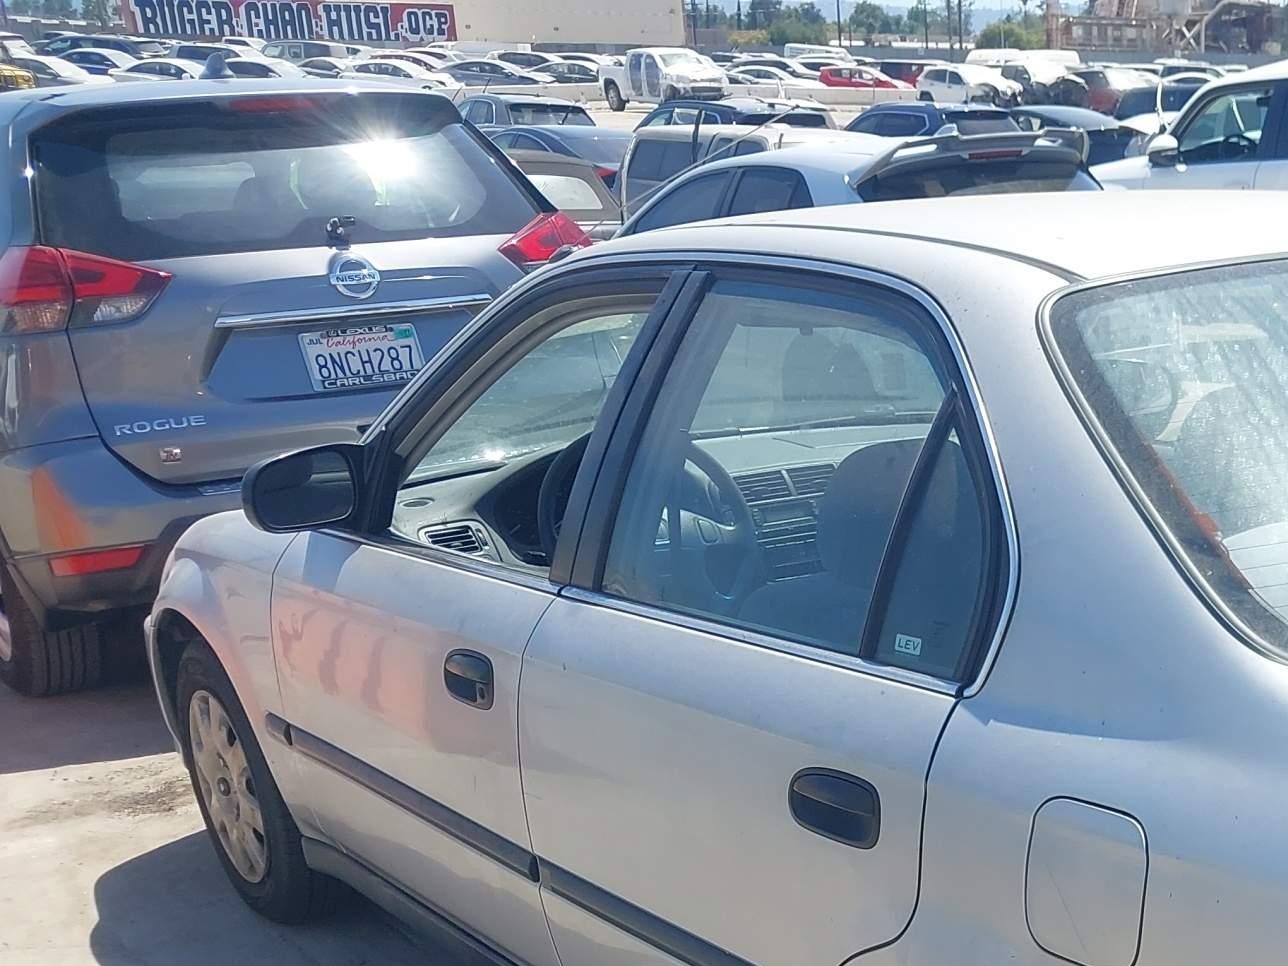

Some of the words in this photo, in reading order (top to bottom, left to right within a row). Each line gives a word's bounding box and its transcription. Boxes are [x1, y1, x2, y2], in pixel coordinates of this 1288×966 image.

[336, 273, 376, 282] NISSAN
[338, 325, 386, 336] LEXUS
[327, 335, 393, 349] California
[315, 344, 415, 379] 8NCH287
[113, 415, 207, 436] ROGUE
[897, 638, 920, 651] LEV
